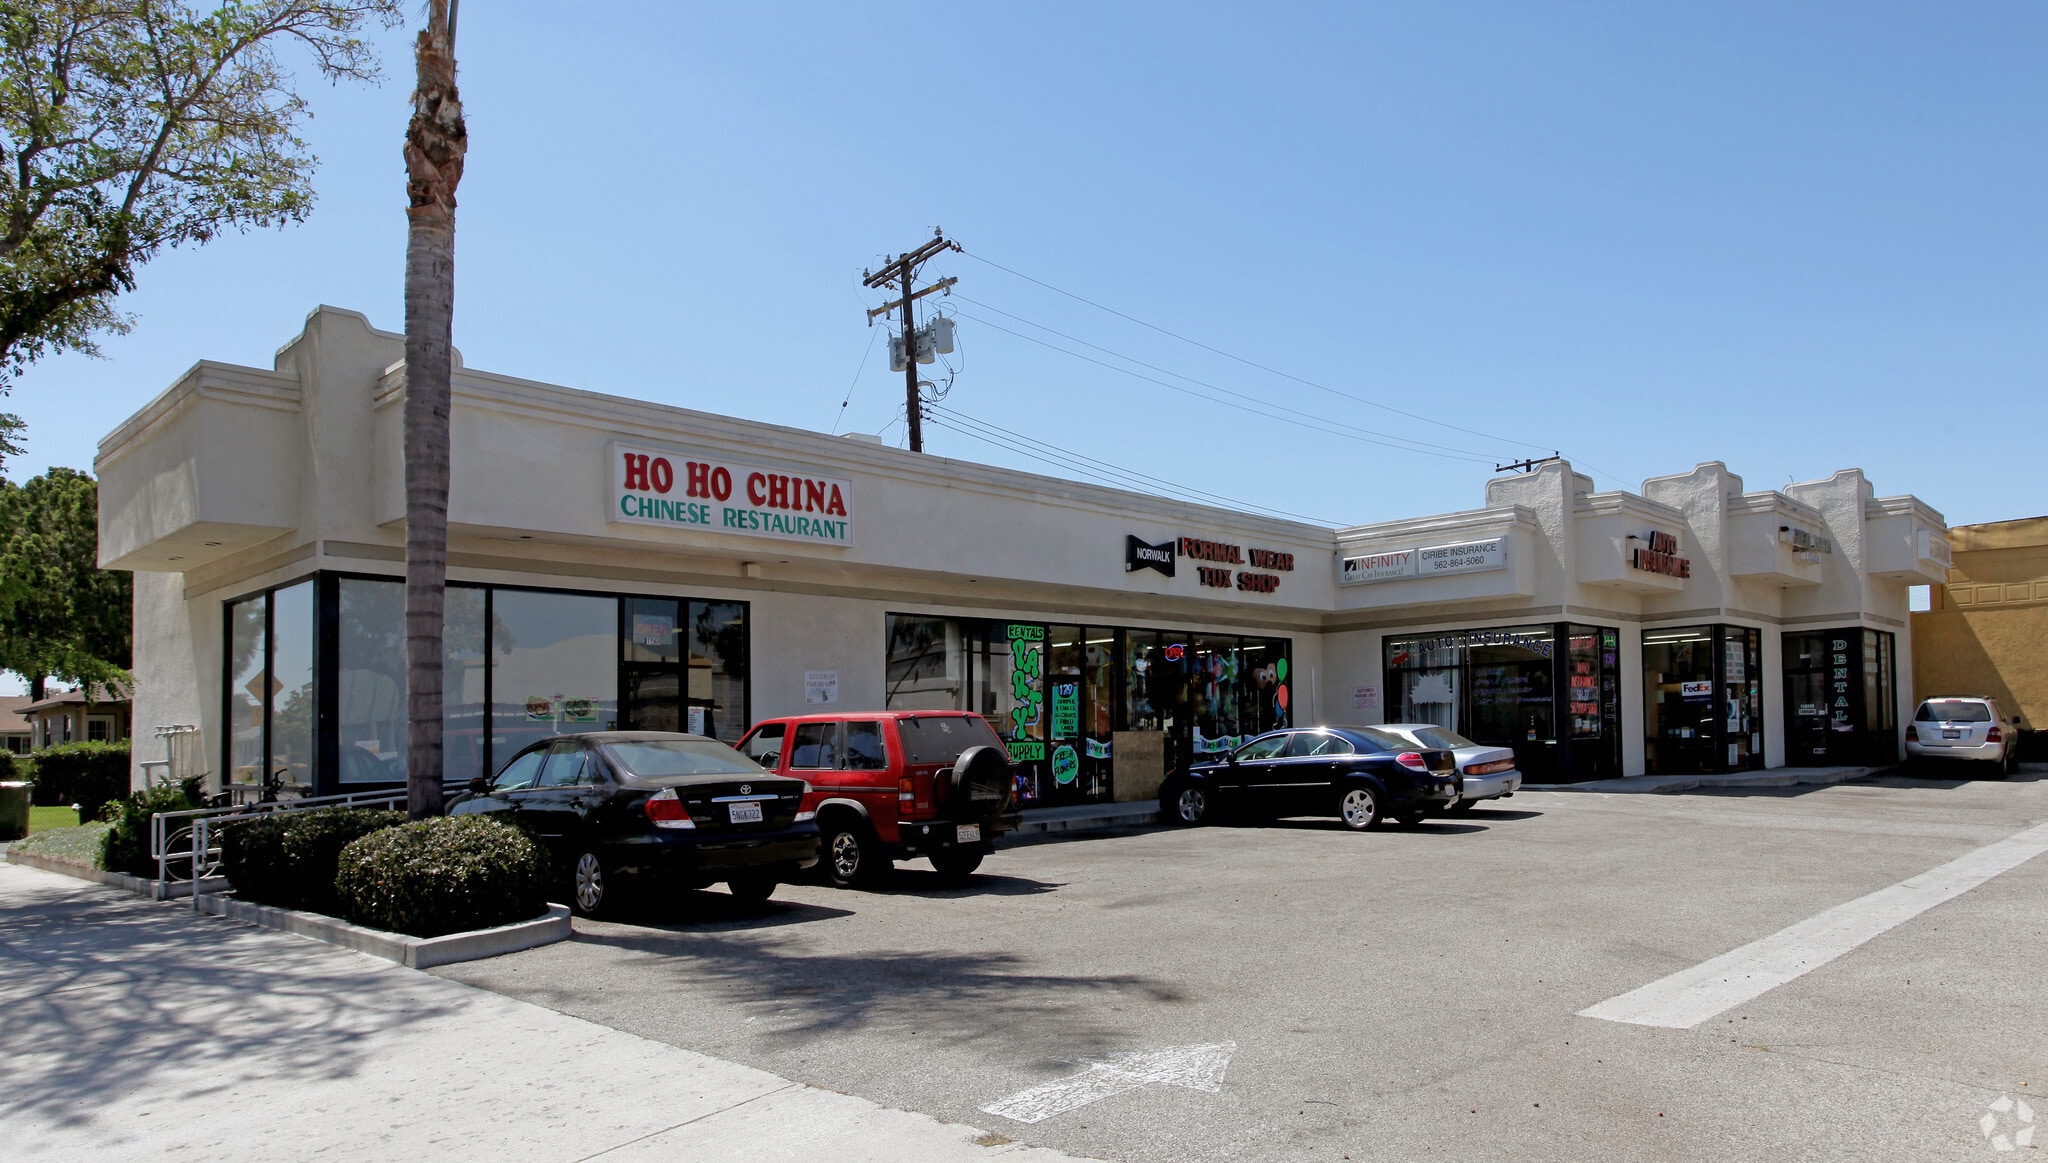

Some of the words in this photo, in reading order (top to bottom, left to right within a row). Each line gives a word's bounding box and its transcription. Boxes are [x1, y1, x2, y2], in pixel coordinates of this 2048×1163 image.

[624, 453, 673, 493] HO
[686, 461, 732, 501] HO
[747, 472, 847, 516] CHINA
[620, 494, 710, 524] CHINESE
[723, 507, 847, 539] RESTAURANT
[1136, 547, 1170, 563] NORWALK
[1179, 537, 1245, 564] FORMAL
[1249, 549, 1295, 571] WEAR
[1450, 542, 1497, 556] INSURANCE
[1650, 531, 1677, 555] AUTO
[1357, 552, 1410, 571] INFINITY
[1433, 555, 1485, 570] 562-864-5060
[1635, 549, 1690, 578] INSURANCE
[1198, 567, 1233, 588] TUX
[1238, 572, 1280, 593] SHOP
[1009, 627, 1044, 639] RENTALS
[1418, 635, 1454, 655] AUTO
[1468, 631, 1553, 658] INSURANCE
[1011, 638, 1043, 741] PARTY
[1683, 683, 1710, 693] FedEx
[1832, 639, 1849, 721] DENTAL
